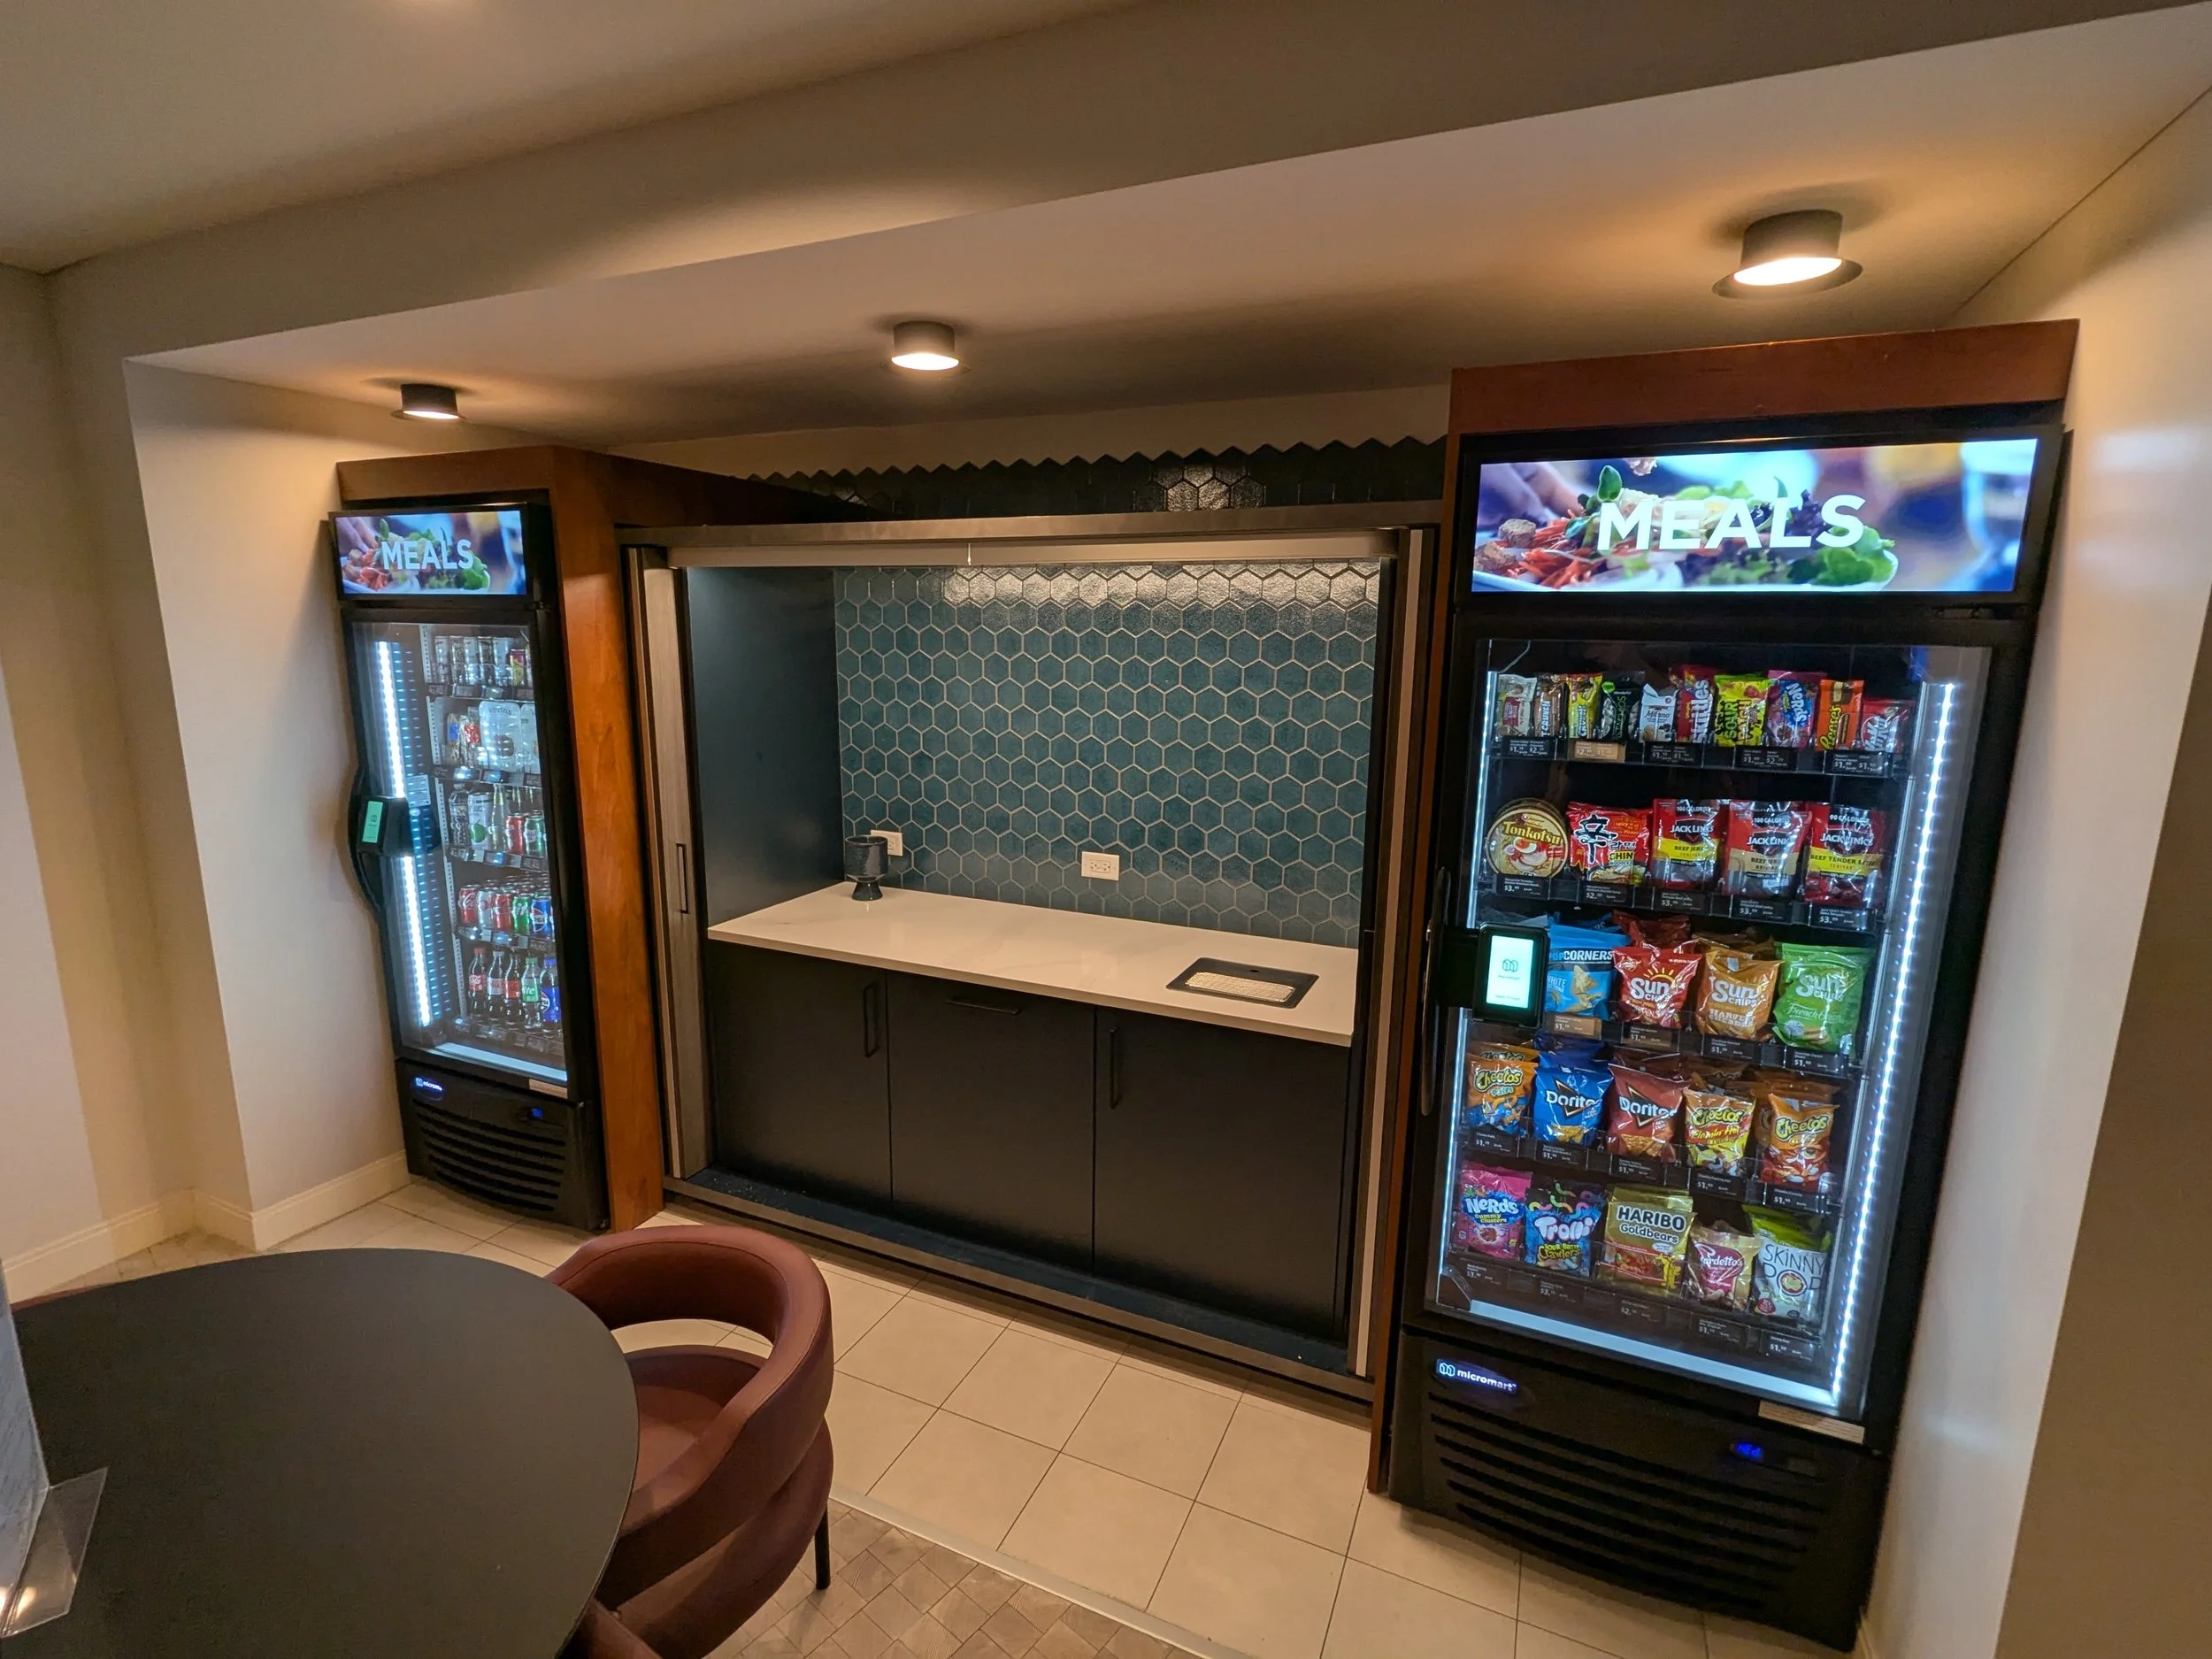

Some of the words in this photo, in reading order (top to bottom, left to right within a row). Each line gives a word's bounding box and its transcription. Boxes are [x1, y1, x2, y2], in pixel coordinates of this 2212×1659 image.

[1597, 494, 1867, 551] MEALS
[381, 539, 473, 571] MEALS
[1691, 680, 1710, 743] Skittles
[1786, 682, 1809, 724] Nerds
[1646, 710, 1671, 718] Milano
[1724, 699, 1739, 740] SOUR
[1820, 706, 1843, 750] Reese's
[1503, 821, 1563, 846] Tonkotsu
[1670, 825, 1692, 833] JACK
[1820, 833, 1844, 842] JACK
[1746, 836, 1769, 845] JACK
[1609, 851, 1634, 861] SHIN
[1829, 856, 1856, 864] TENDER
[1631, 977, 1670, 1000] Sun
[1711, 979, 1756, 1003] Sun
[1795, 975, 1842, 998] Sun
[1727, 997, 1757, 1007] CHIPS
[1785, 1003, 1817, 1018] French
[1475, 1070, 1522, 1090] Cheetos
[1546, 1090, 1602, 1108] Doritos
[1618, 1095, 1678, 1119] Doritos
[1692, 1108, 1744, 1125] Cheetos
[1724, 1125, 1740, 1135] Hot
[1775, 1116, 1830, 1140] Cheetos
[1466, 1197, 1518, 1215] Nerds
[1534, 1216, 1594, 1240] Trolli
[1617, 1206, 1686, 1232] HARIBO
[1620, 1224, 1678, 1244] Goldbears
